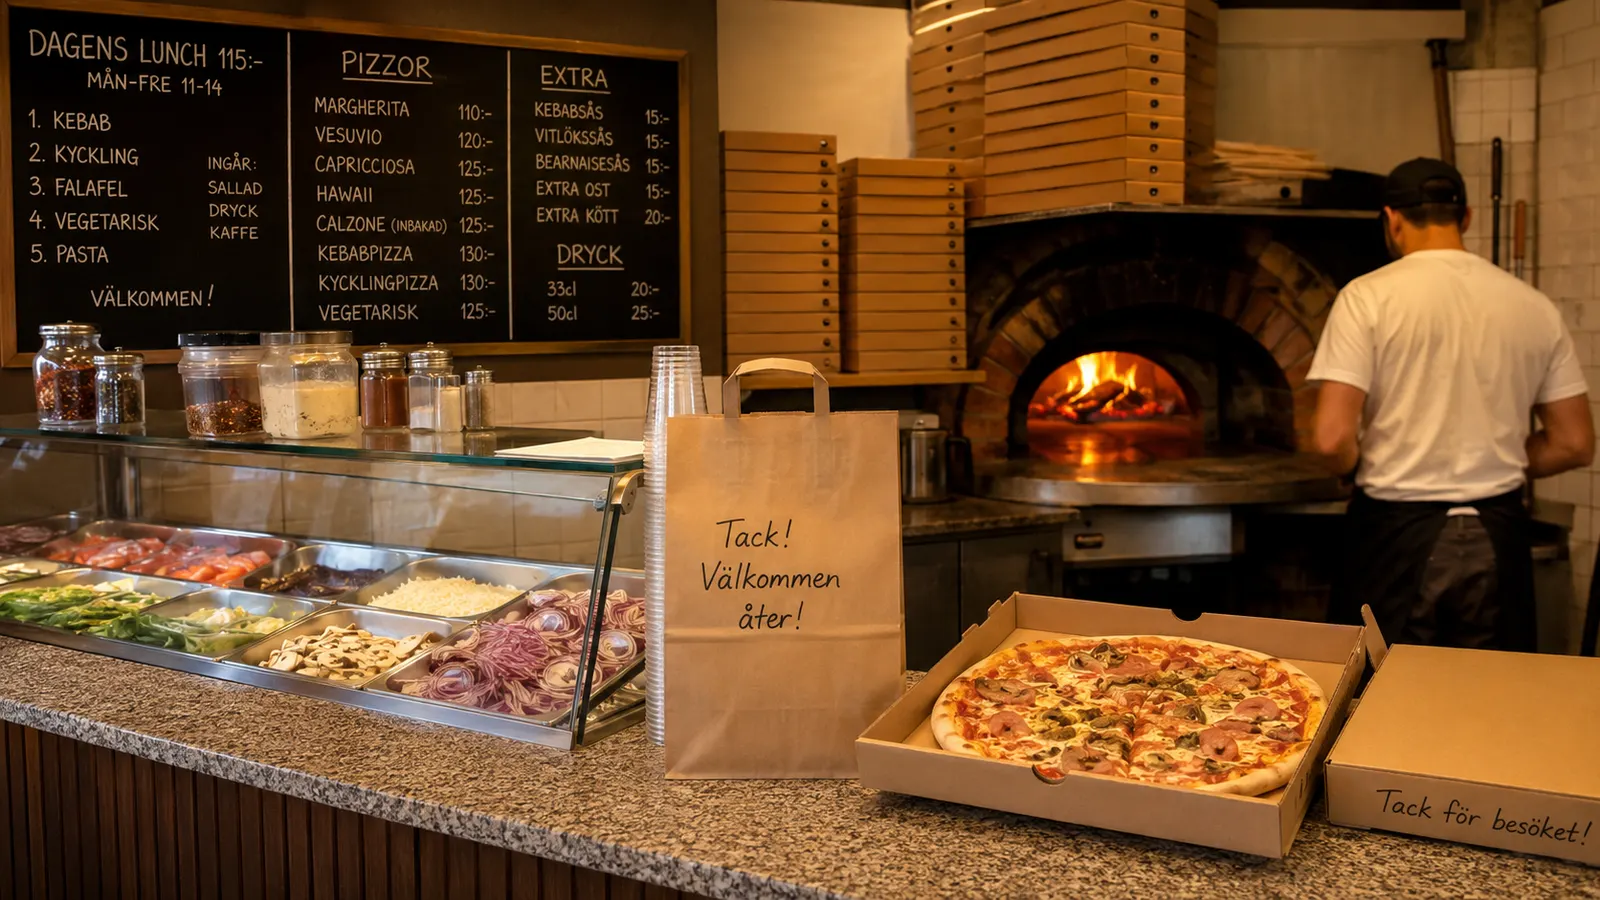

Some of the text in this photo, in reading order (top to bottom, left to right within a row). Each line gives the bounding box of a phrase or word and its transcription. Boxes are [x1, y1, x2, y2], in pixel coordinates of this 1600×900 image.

[29, 29, 263, 70] DAGENS LUNCH 115:-
[342, 50, 432, 78] PIZZOR
[88, 67, 222, 96] MÅN-FRE 11-14
[541, 65, 608, 88] EXTRA
[315, 97, 492, 120] MARGHERITA 110:-
[535, 101, 669, 124] KEBABSÅS 15:-
[29, 109, 111, 131] 1. KEBAB
[315, 126, 493, 148] VESUVIO 120:-
[535, 126, 669, 149] VITLÖKSSÅS 15:-
[29, 143, 138, 165] 2. KYCKLING
[209, 152, 256, 171] INGÅR:
[536, 154, 669, 174] BEARNAISESÅS 15:-
[315, 155, 493, 177] CAPRICCIOSA 125:-
[30, 176, 128, 197] 3. FALAFEL
[208, 181, 262, 195] SALLAD
[317, 185, 493, 205] HAWAII 125:-
[537, 180, 670, 199] EXTRA OST 15:-
[29, 210, 159, 230] 4. VEGETARISK
[210, 204, 258, 217] DRYCK
[537, 206, 670, 225] EXTRA KÖTT 20:-
[211, 226, 258, 239] KAFFE
[317, 215, 493, 234] CALZONE (INBAKAD) 125:-
[31, 244, 108, 263] 5. PASTA
[319, 245, 494, 262] KEBABPIZZA 130:-
[557, 244, 623, 264] DRYCK
[319, 274, 495, 291] KYCKLINGPIZZA 130:-
[548, 281, 659, 296] 33cl 20:-
[91, 284, 213, 307] VÄLKOMMEN!
[319, 303, 495, 321] VEGETARISK 125:-
[548, 305, 659, 321] 50cl 25:-
[716, 519, 792, 548] Tack!
[702, 561, 840, 590] Välkommen
[739, 601, 803, 630] åter!
[1376, 789, 1592, 845] Tack för besöket!
